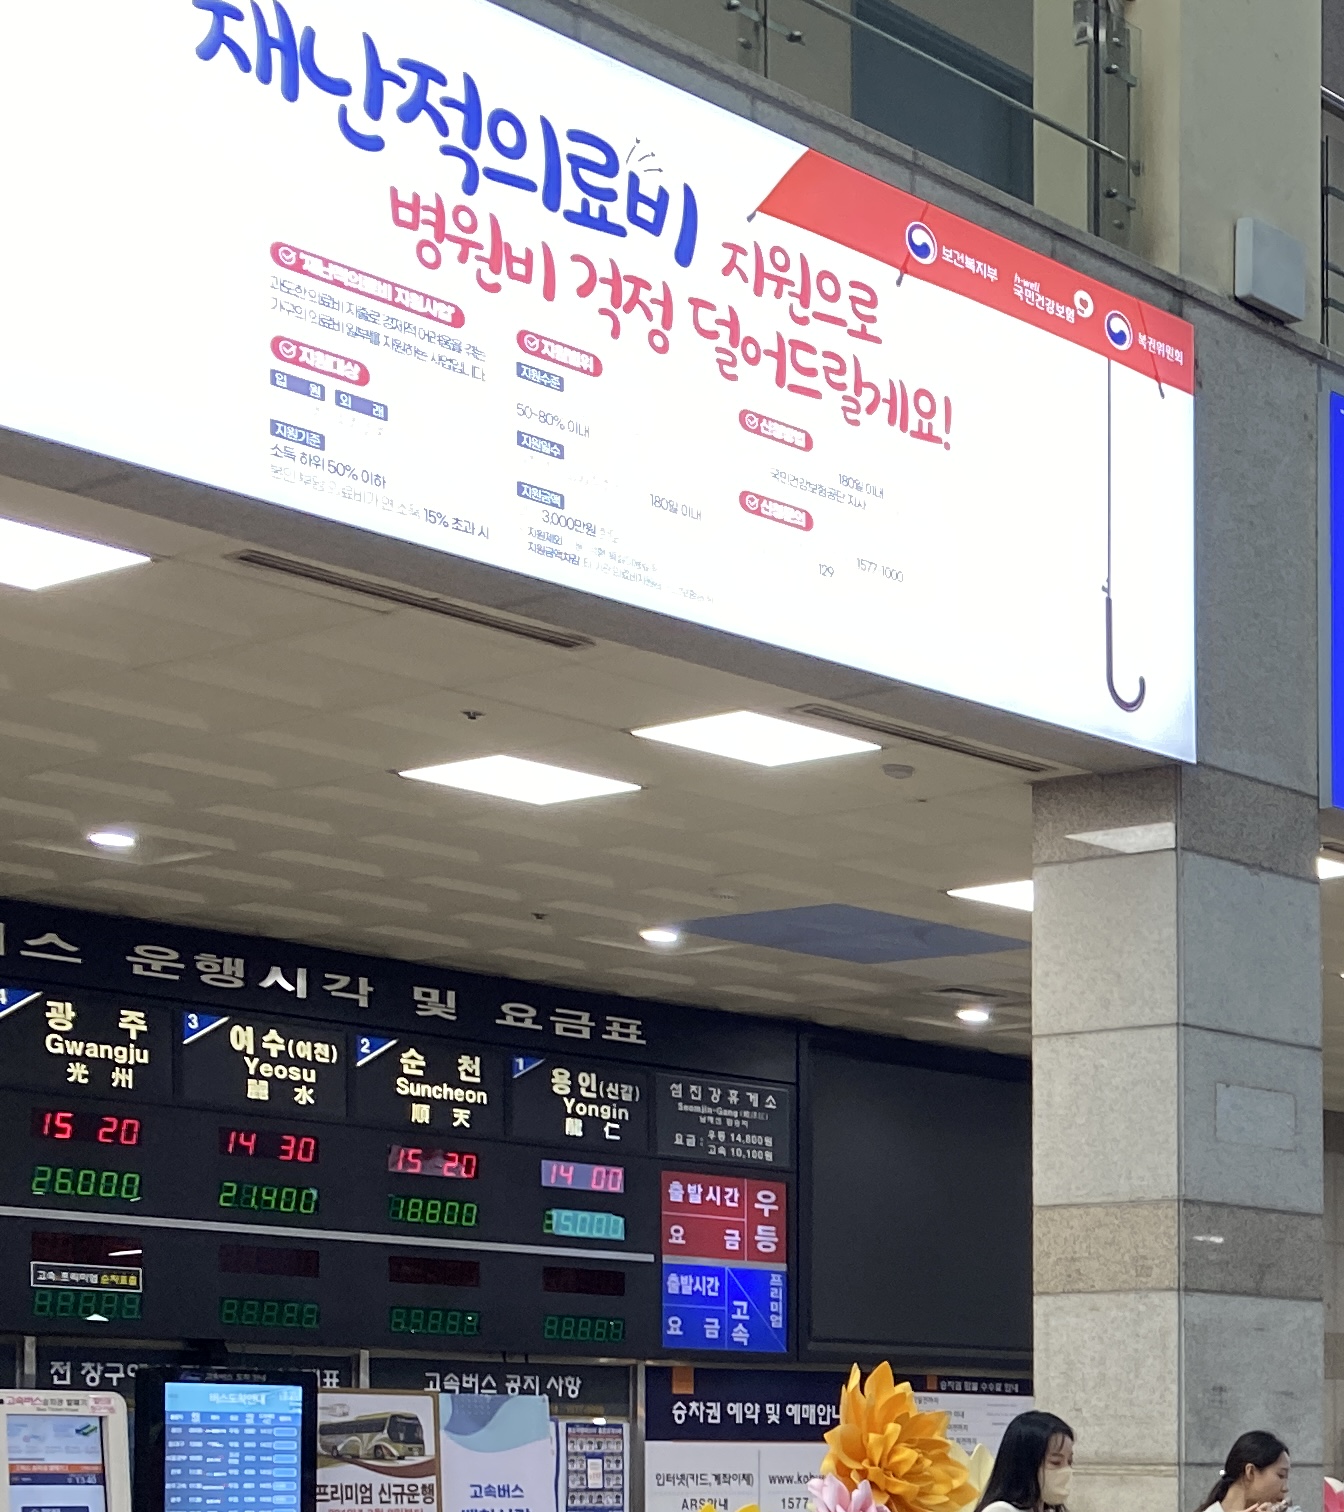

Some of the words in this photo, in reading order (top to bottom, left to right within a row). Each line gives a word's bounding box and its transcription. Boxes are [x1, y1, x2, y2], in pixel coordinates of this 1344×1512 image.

[194, 0, 698, 268] 재난적의료비
[942, 245, 998, 283] 보건복지부
[721, 241, 883, 345] 지원으로
[1013, 284, 1075, 324] 국민건강보험
[389, 186, 557, 302] 병원비
[568, 252, 673, 354] 걱정
[692, 296, 952, 450] 덜어드릴게요!
[1138, 332, 1184, 366] 복권위원회
[327, 458, 359, 482] 50%
[423, 507, 450, 528] 15%
[125, 943, 375, 1009] 운행시각
[412, 985, 458, 1022] 및
[495, 1002, 647, 1046] 요금표
[187, 1013, 200, 1030] 3
[45, 1033, 150, 1066] Gwangju
[359, 1038, 371, 1054] 2
[243, 1056, 317, 1083] Yeosu
[516, 1056, 526, 1071] 1
[395, 1077, 487, 1105] Suncheon
[563, 1097, 630, 1122] Yongin
[668, 1181, 740, 1208] 출발시간
[666, 1272, 720, 1297] 출발시간
[50, 1361, 71, 1386] 전
[423, 1371, 497, 1395] 고속버스
[504, 1373, 541, 1397] 공지
[546, 1375, 582, 1398] 사항
[671, 1400, 721, 1425] 승차권
[726, 1401, 760, 1425] 예약
[765, 1402, 780, 1424] 및
[316, 1483, 373, 1505] 프리미엄
[377, 1482, 435, 1505] 신규운행
[469, 1484, 525, 1499] 고속버스
